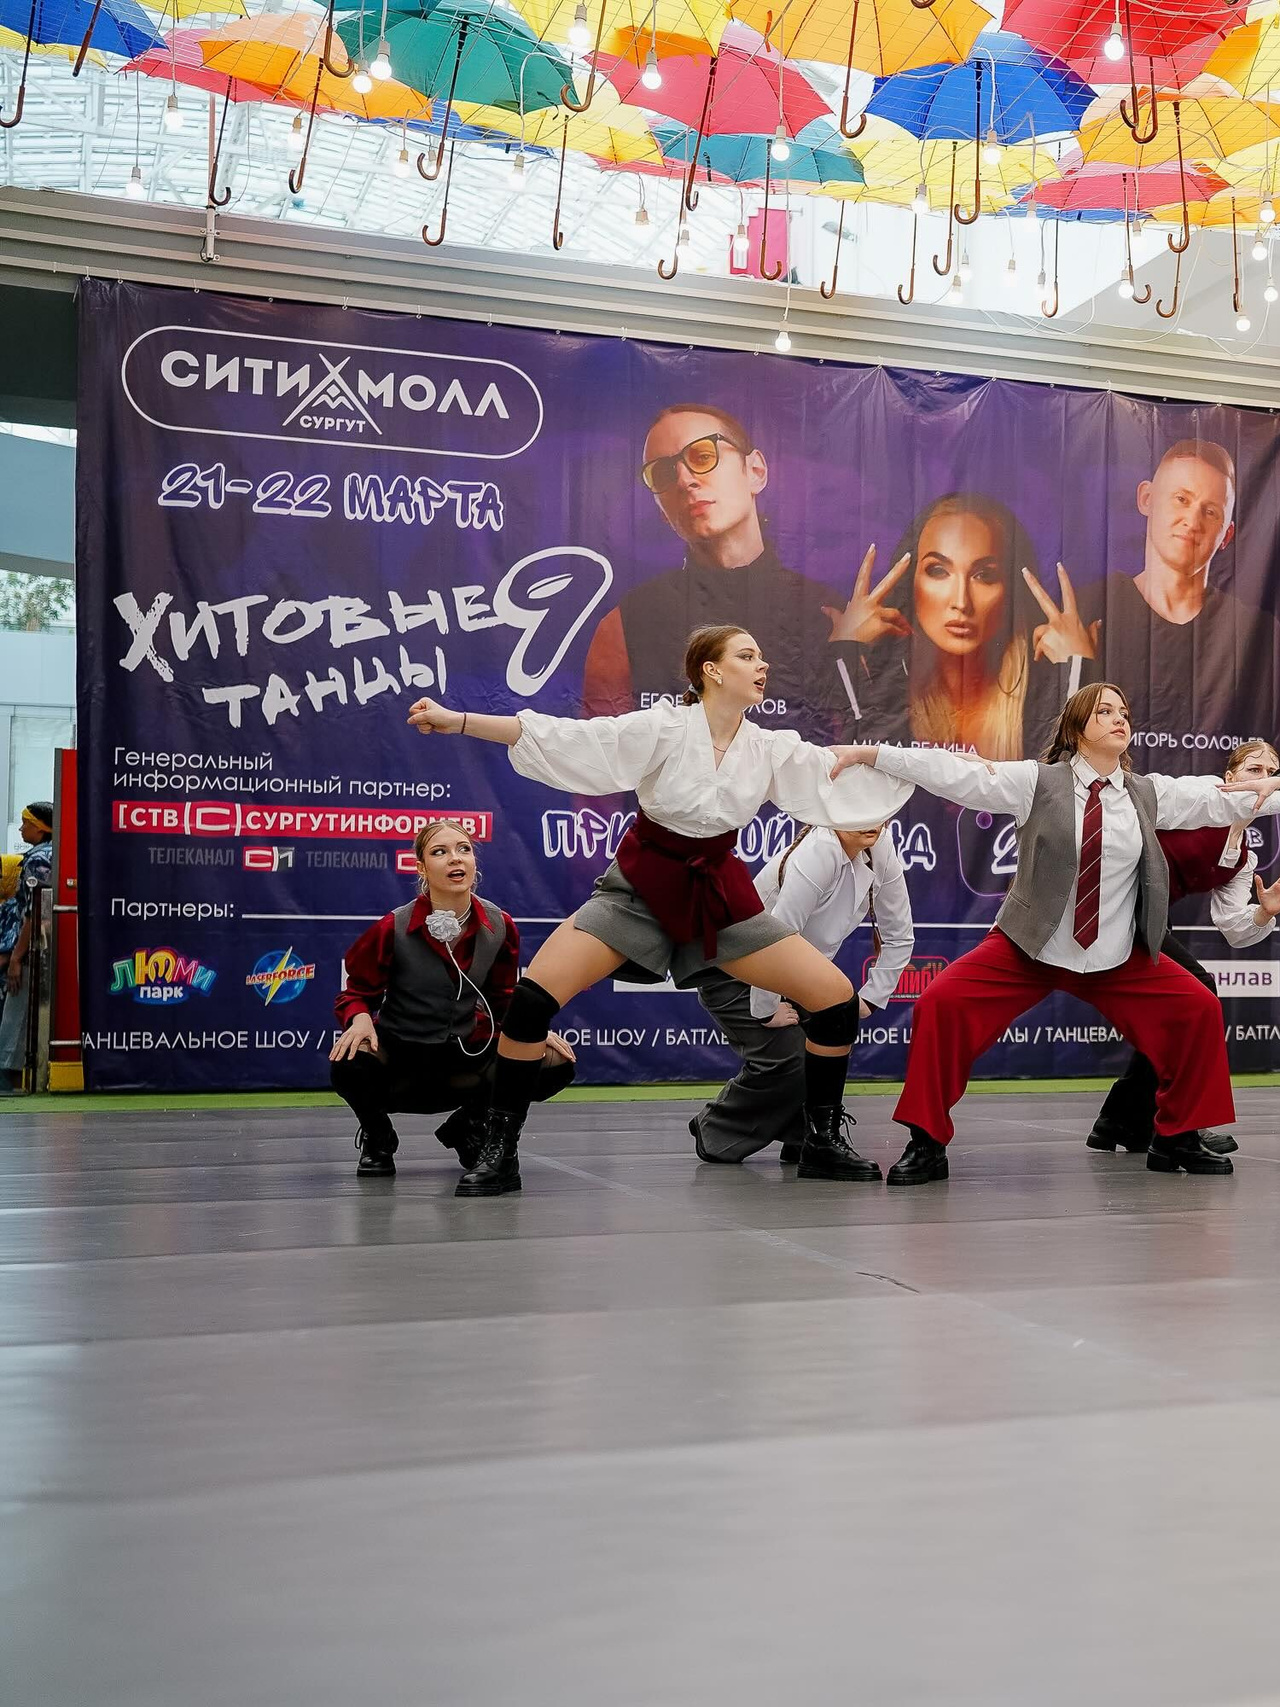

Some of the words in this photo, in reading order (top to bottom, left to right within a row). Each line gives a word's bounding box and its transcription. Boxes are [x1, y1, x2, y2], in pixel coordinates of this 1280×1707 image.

[300, 415, 366, 434] СУРГУТ
[158, 462, 332, 519] 21-22
[343, 472, 504, 531] МАРТА
[113, 585, 500, 683] ХИТОВЫЕ
[202, 645, 448, 728] ТАНЦЫ
[1182, 733, 1265, 750] СОЛОВ
[114, 747, 273, 771] Генеральный
[113, 769, 342, 795] информационный
[349, 779, 451, 801] партнер:
[148, 847, 234, 866] ТЕЛЕКАНАЛ
[306, 851, 388, 869] ТЕЛЕКАНАЛ
[111, 897, 235, 922] Партнеры:
[111, 950, 218, 993] ЛЮМИ
[139, 985, 184, 1002] парк
[82, 1030, 248, 1051] АНЦЕВАЛЬНОЕ
[255, 1030, 310, 1049] ШОУ
[597, 1028, 646, 1046] ШОУ
